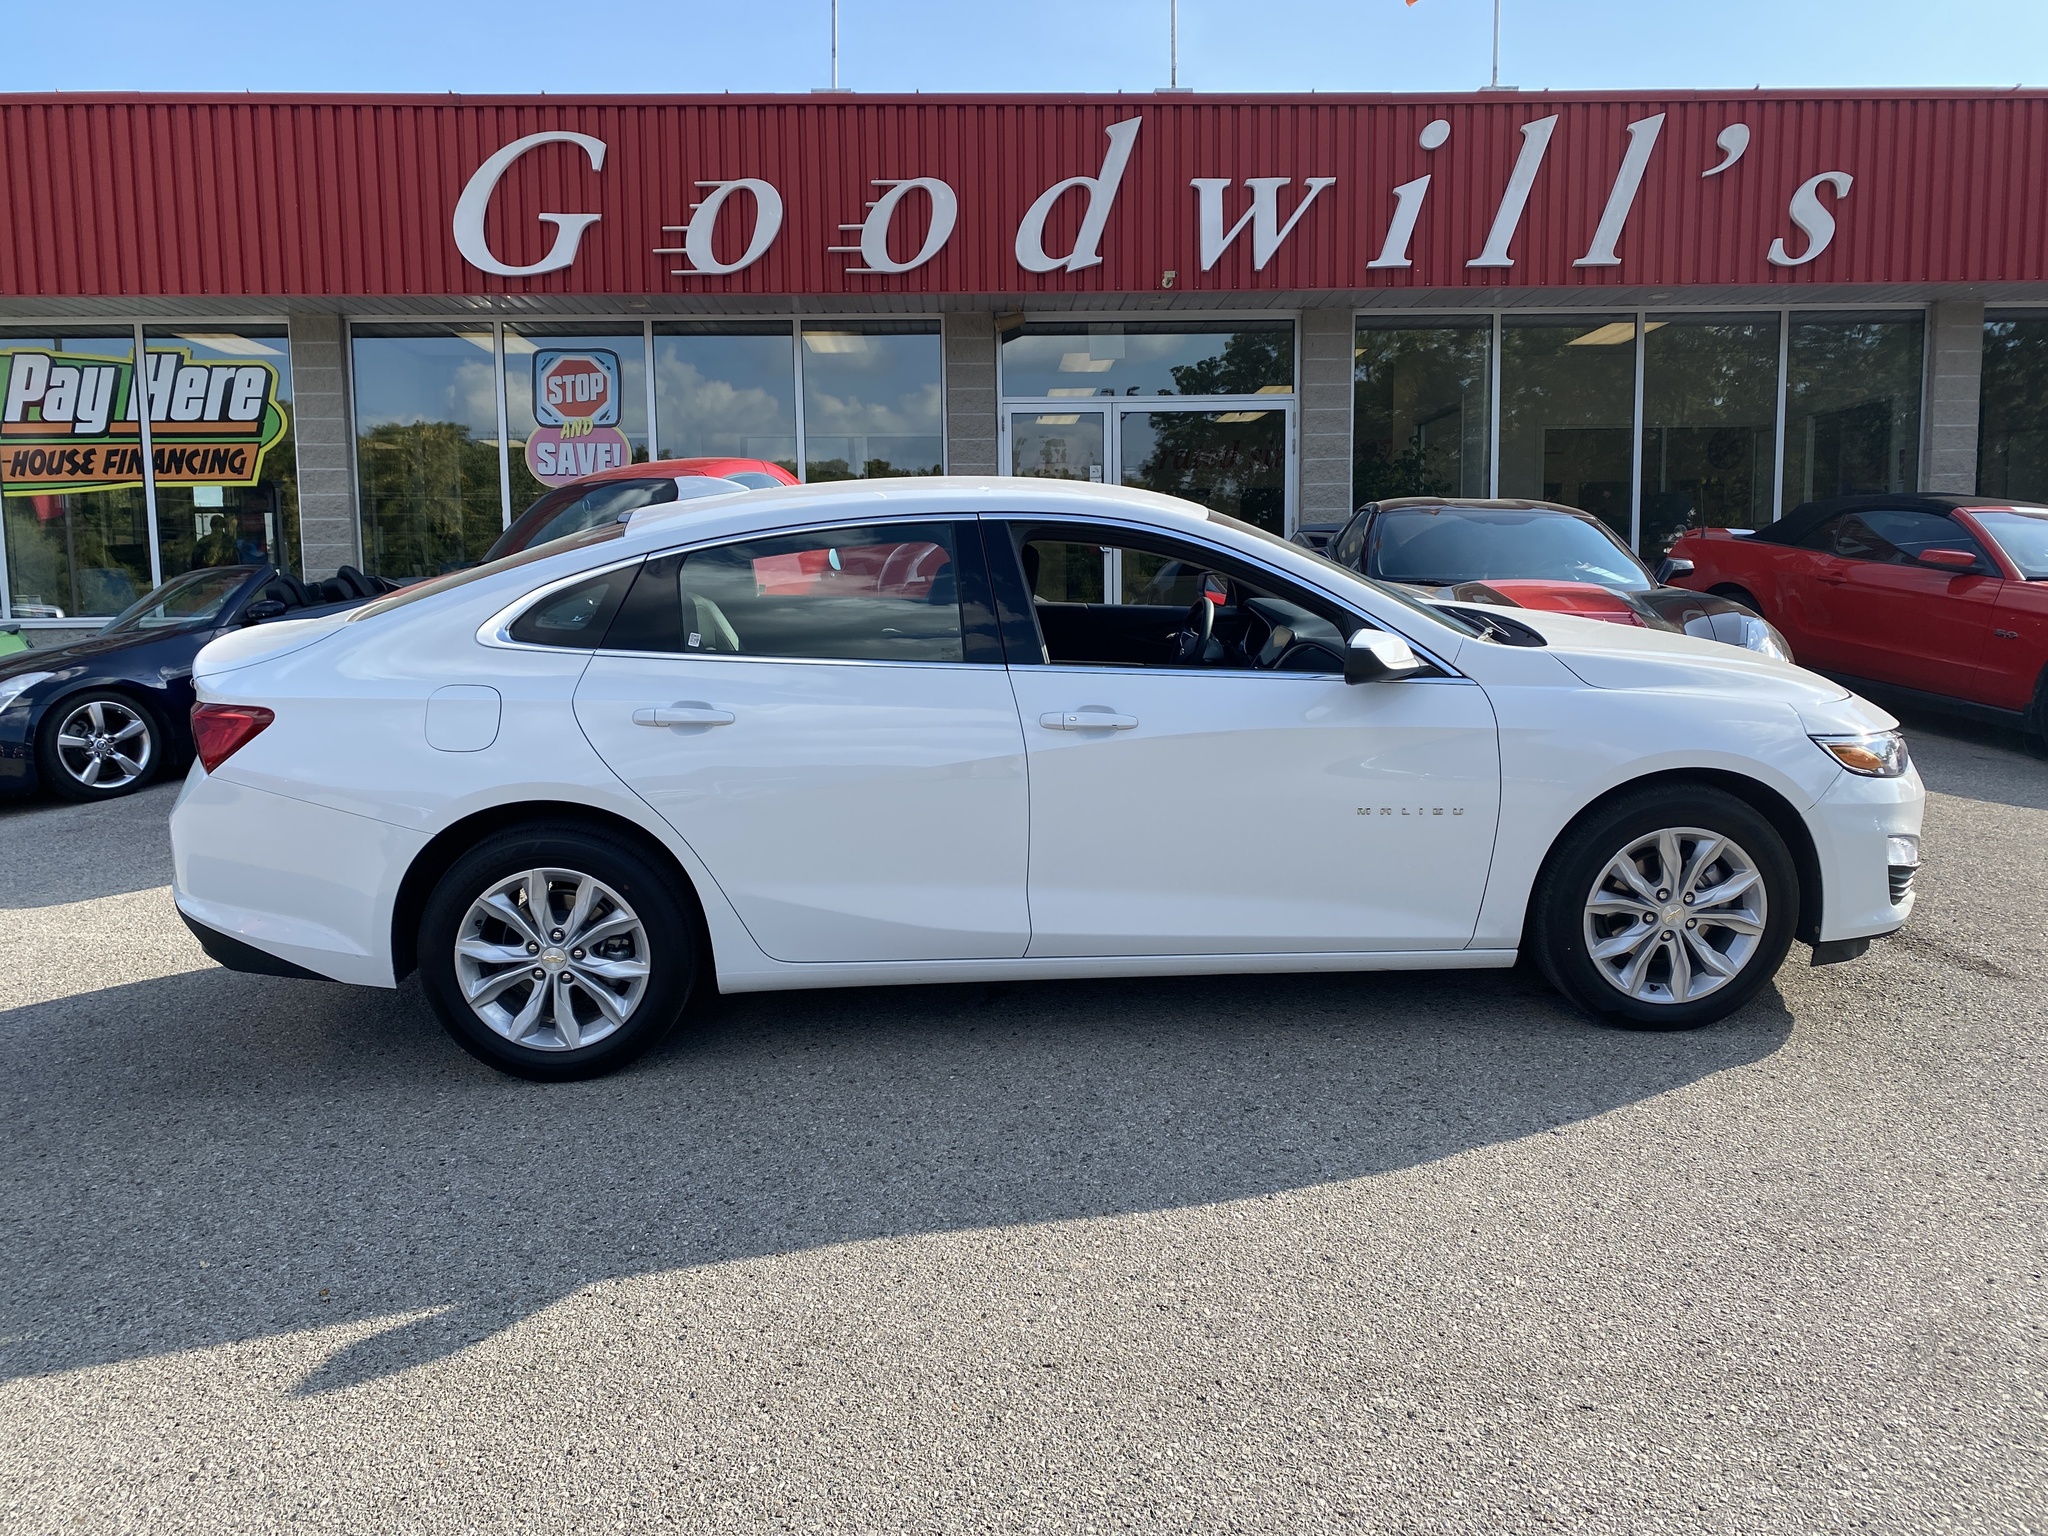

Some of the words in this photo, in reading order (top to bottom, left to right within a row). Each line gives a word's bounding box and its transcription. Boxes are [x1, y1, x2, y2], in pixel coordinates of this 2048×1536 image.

[453, 113, 1854, 279] Goodwill's
[4, 353, 116, 434] Pay
[126, 353, 267, 422] Here
[548, 372, 604, 405] STOP
[560, 417, 594, 440] AND
[102, 447, 247, 476] FINANCING
[536, 441, 622, 477] SAVE!
[1356, 806, 1465, 816] MALIBU
